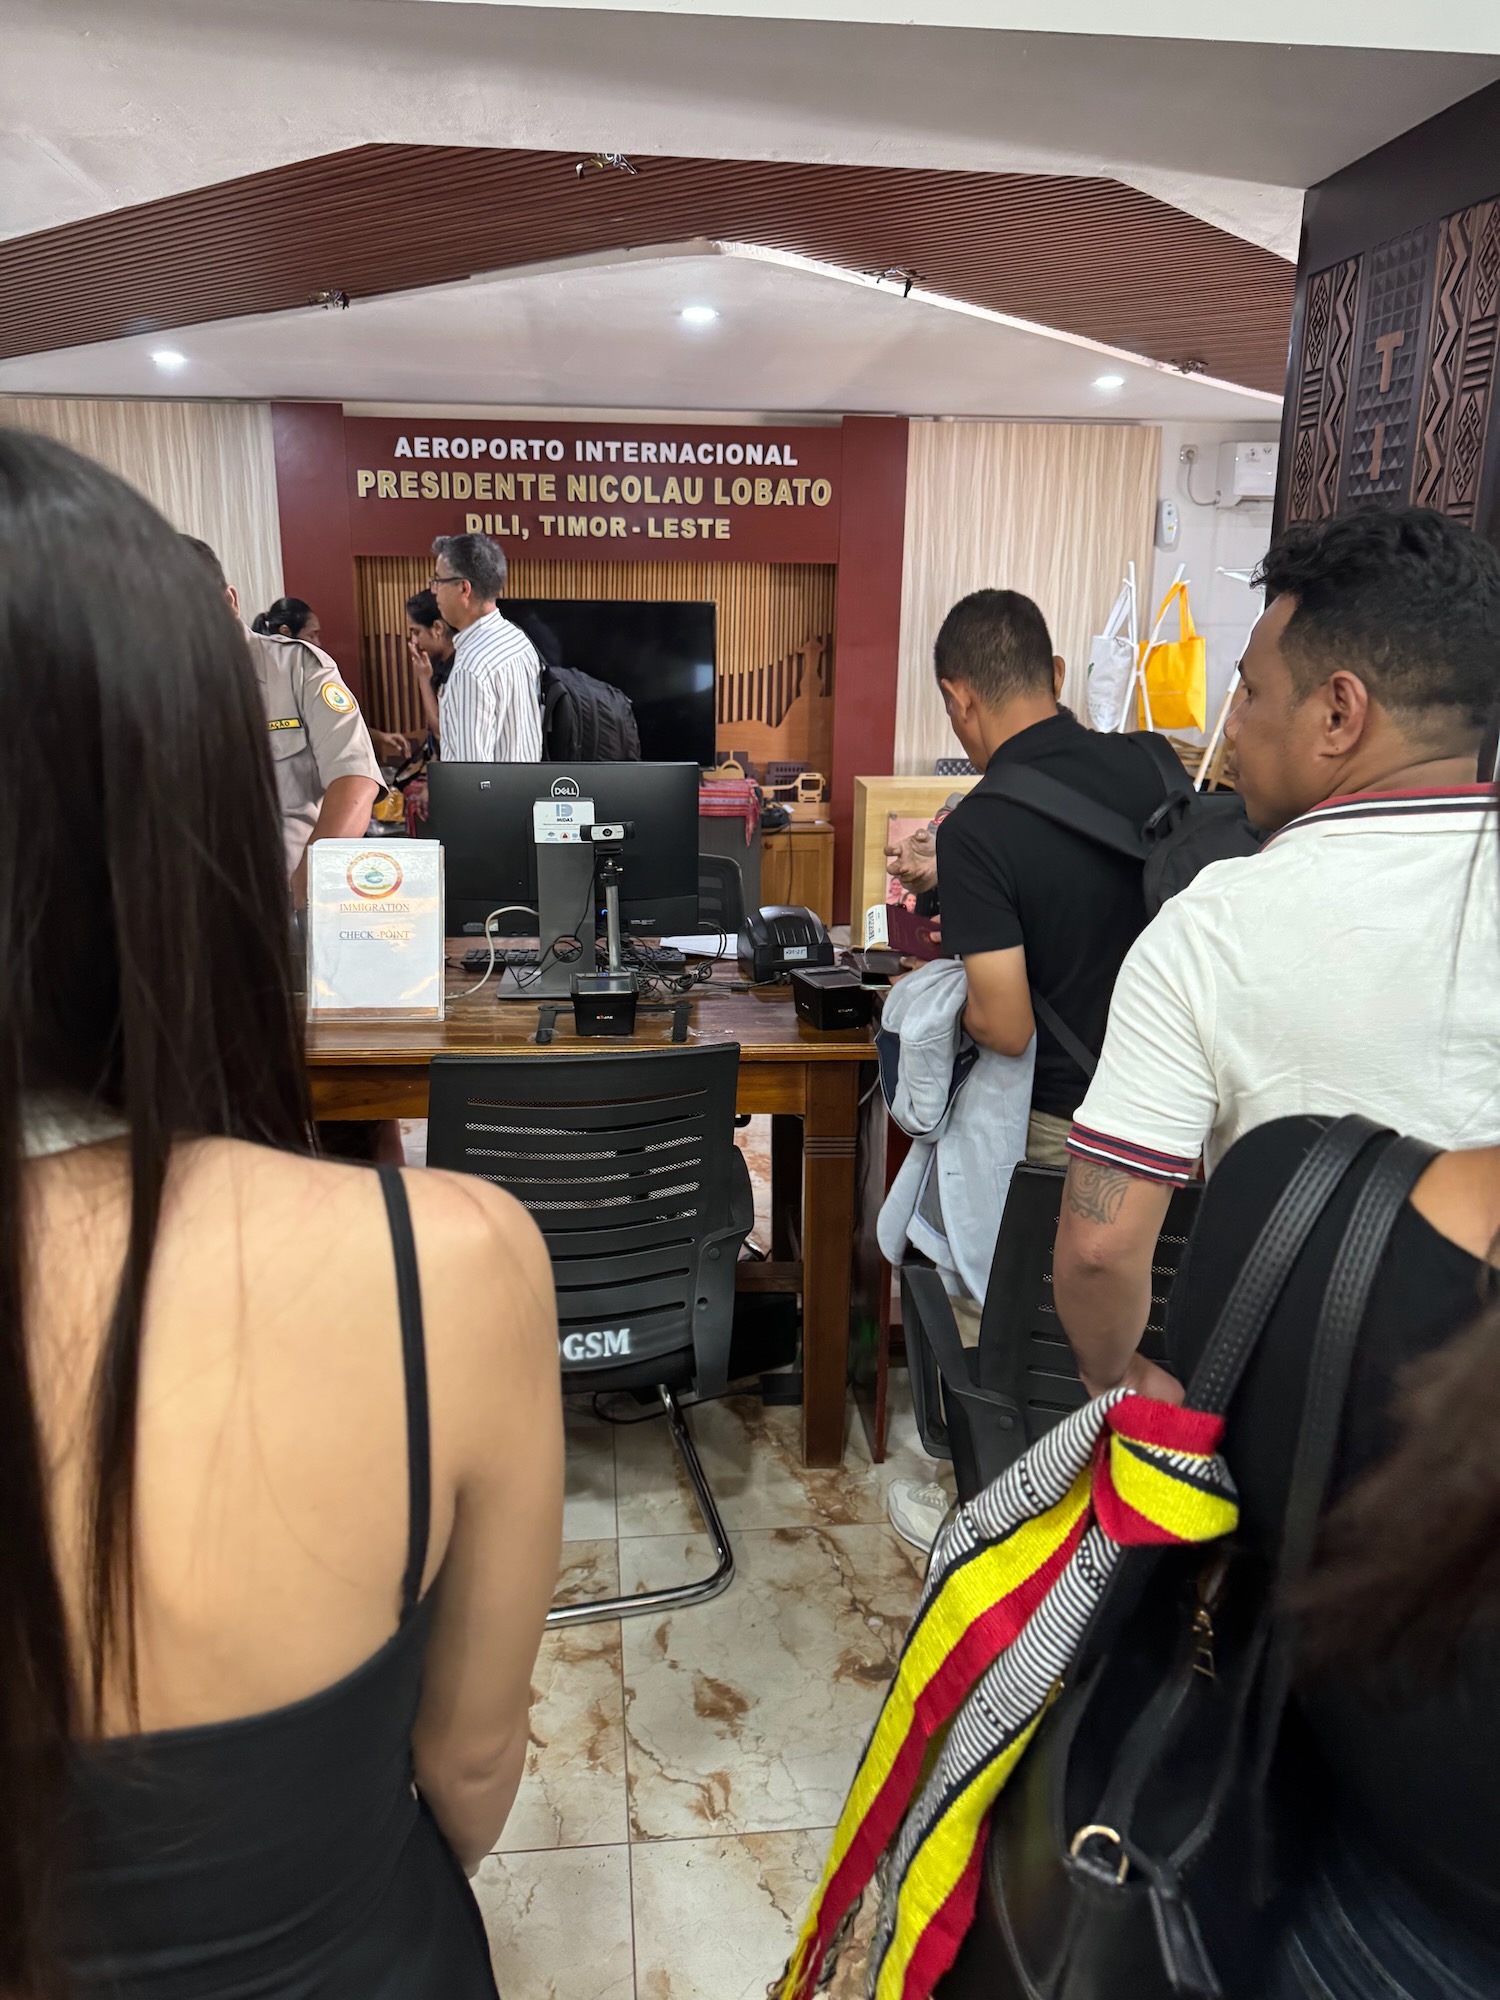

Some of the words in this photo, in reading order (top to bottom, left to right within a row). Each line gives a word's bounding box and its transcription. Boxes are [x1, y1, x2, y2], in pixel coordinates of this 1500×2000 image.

[393, 436, 565, 462] AEROPORTO
[575, 440, 799, 466] INTERNACIONAL
[356, 469, 557, 502] PRESIDENTE
[567, 474, 704, 505] NICOLAU
[714, 477, 833, 507] LOBATO
[465, 513, 530, 541] DILI,
[554, 787, 577, 795] DELL
[339, 903, 410, 912] IMMIGRATION
[339, 930, 374, 939] CHECK
[557, 1328, 631, 1361] GSM
